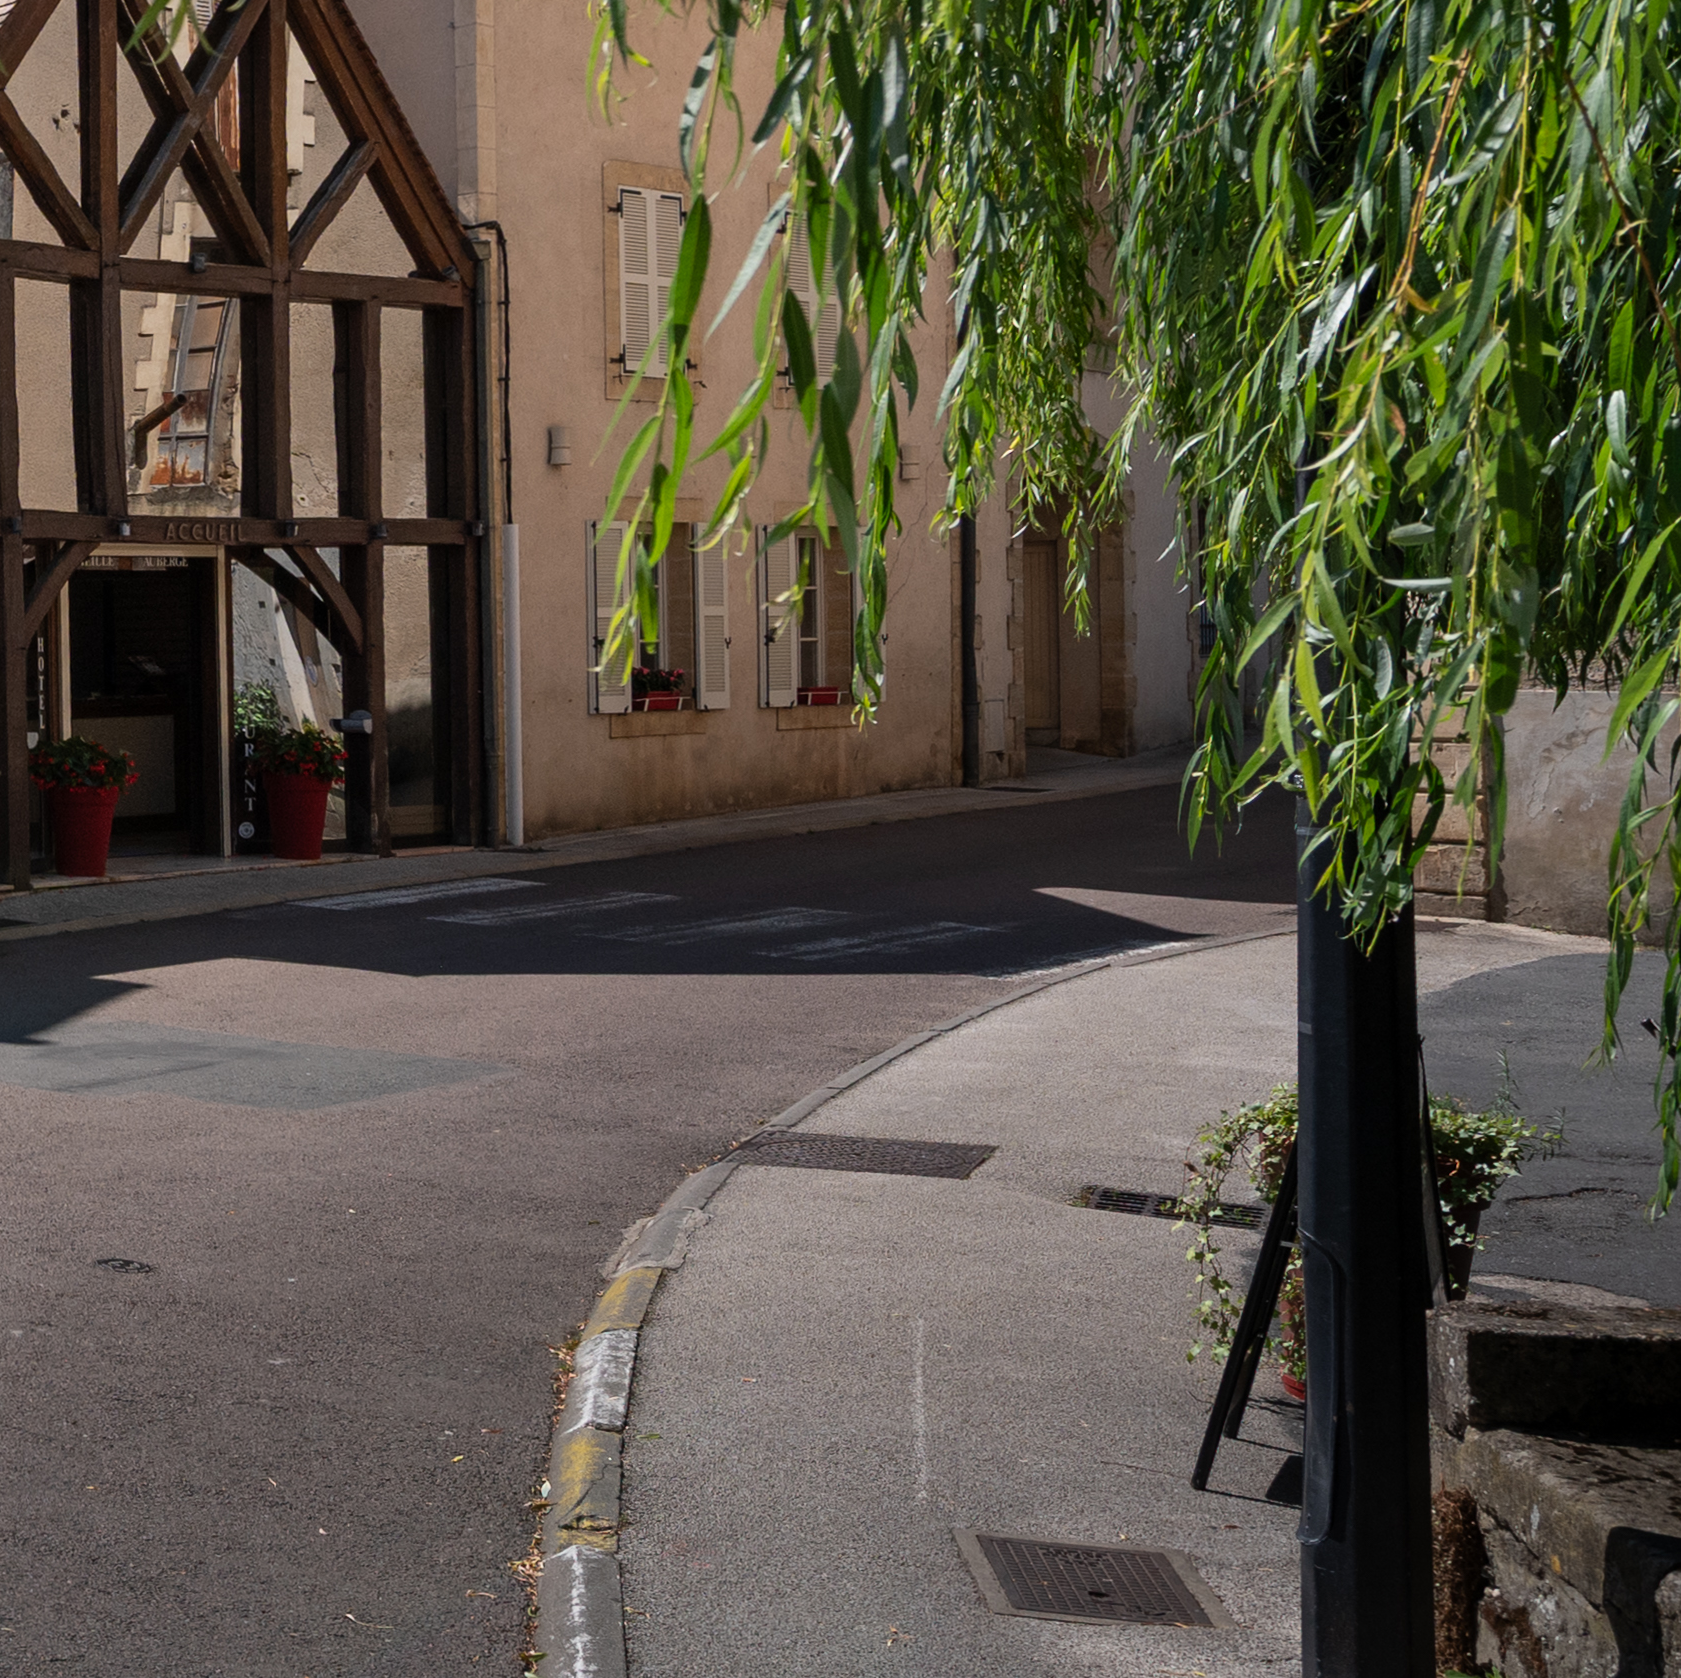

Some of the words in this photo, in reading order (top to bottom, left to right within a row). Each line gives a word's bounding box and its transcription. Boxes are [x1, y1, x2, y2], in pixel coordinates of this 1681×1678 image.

[165, 522, 247, 542] ACCUEIL
[143, 557, 189, 567] AUBERGE
[37, 637, 46, 730] HOTEL
